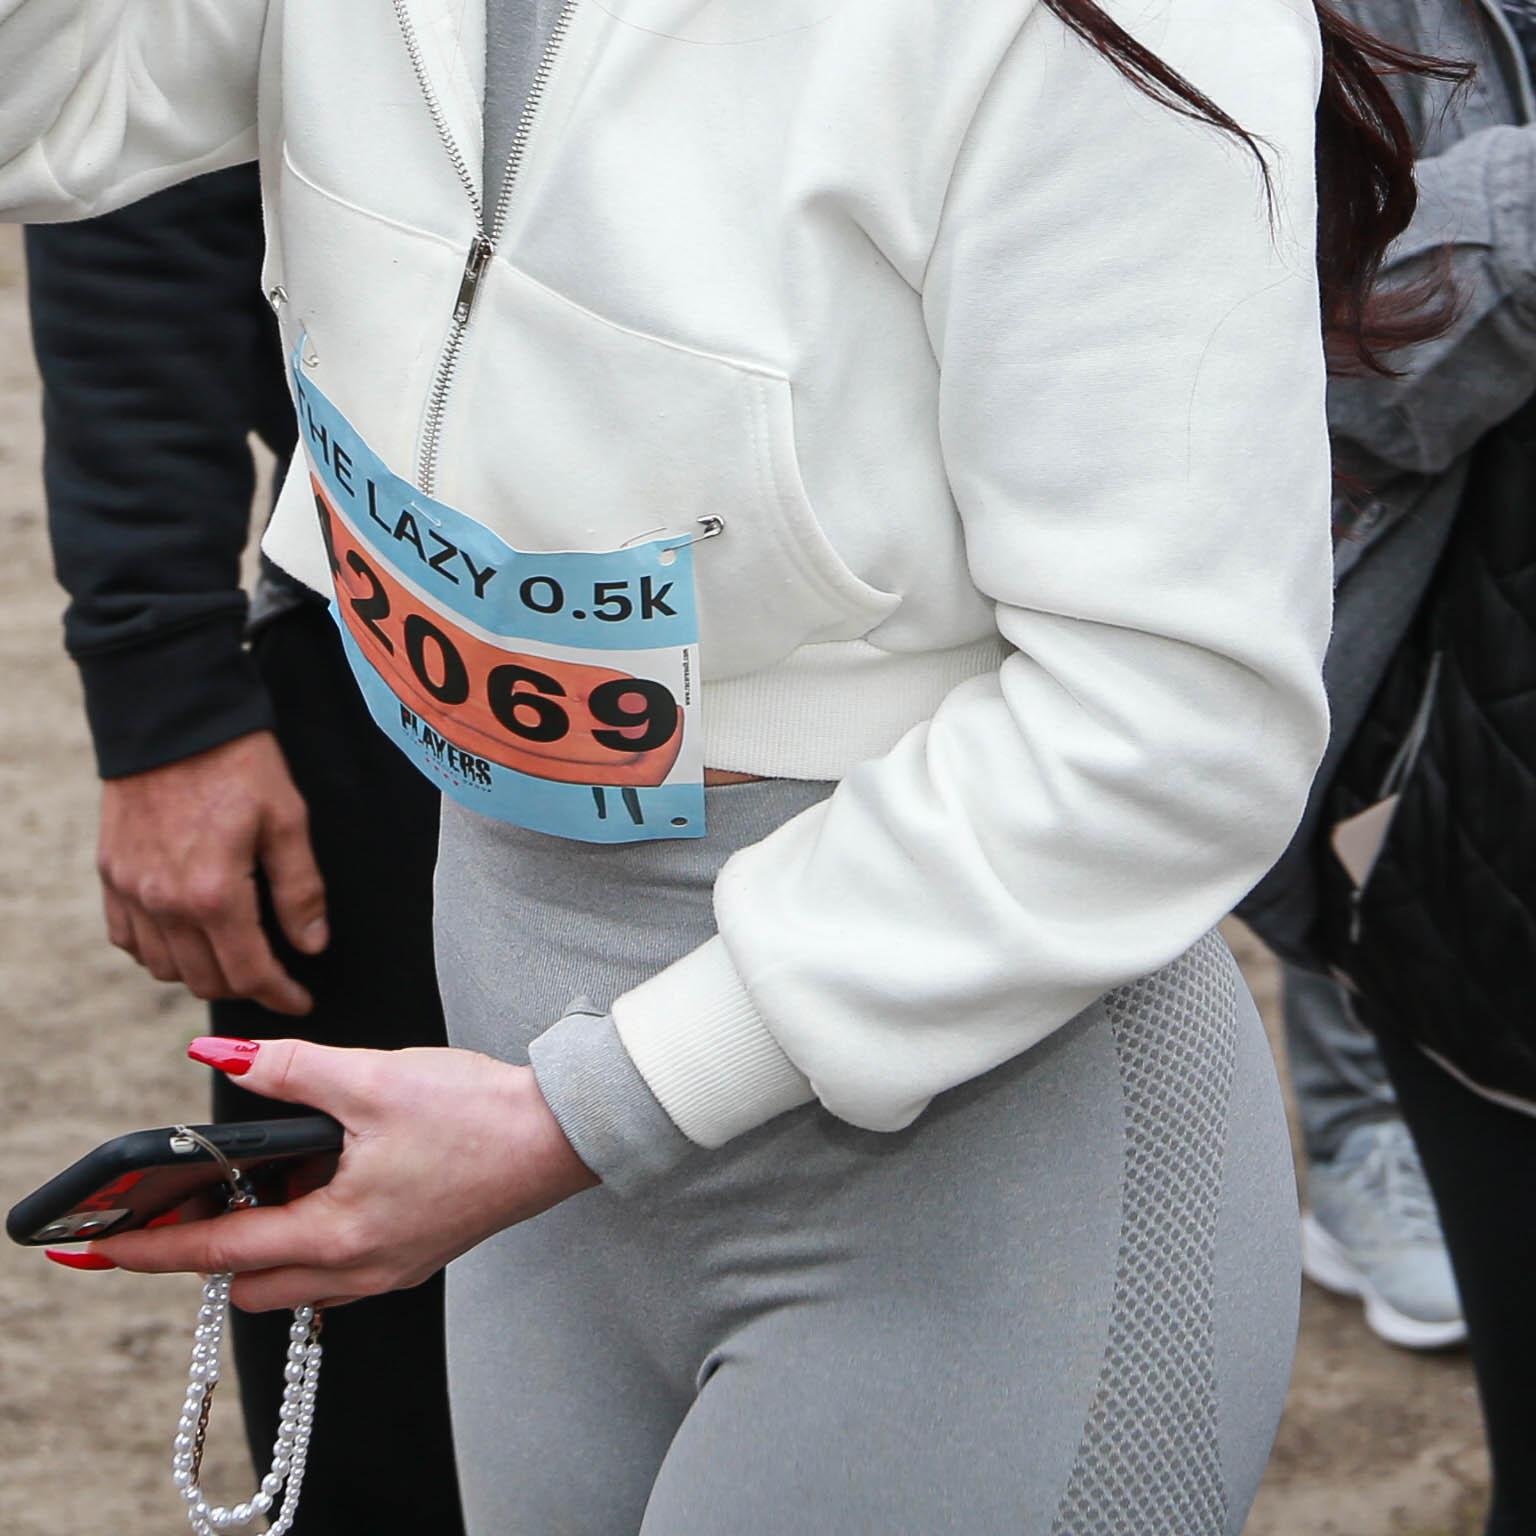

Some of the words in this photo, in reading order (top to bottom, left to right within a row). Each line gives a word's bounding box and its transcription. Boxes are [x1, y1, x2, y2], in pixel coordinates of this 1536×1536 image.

[293, 371, 356, 498] THE
[366, 478, 497, 600] LAZY
[346, 550, 678, 752] 2069
[400, 703, 492, 786] PLAYERS
